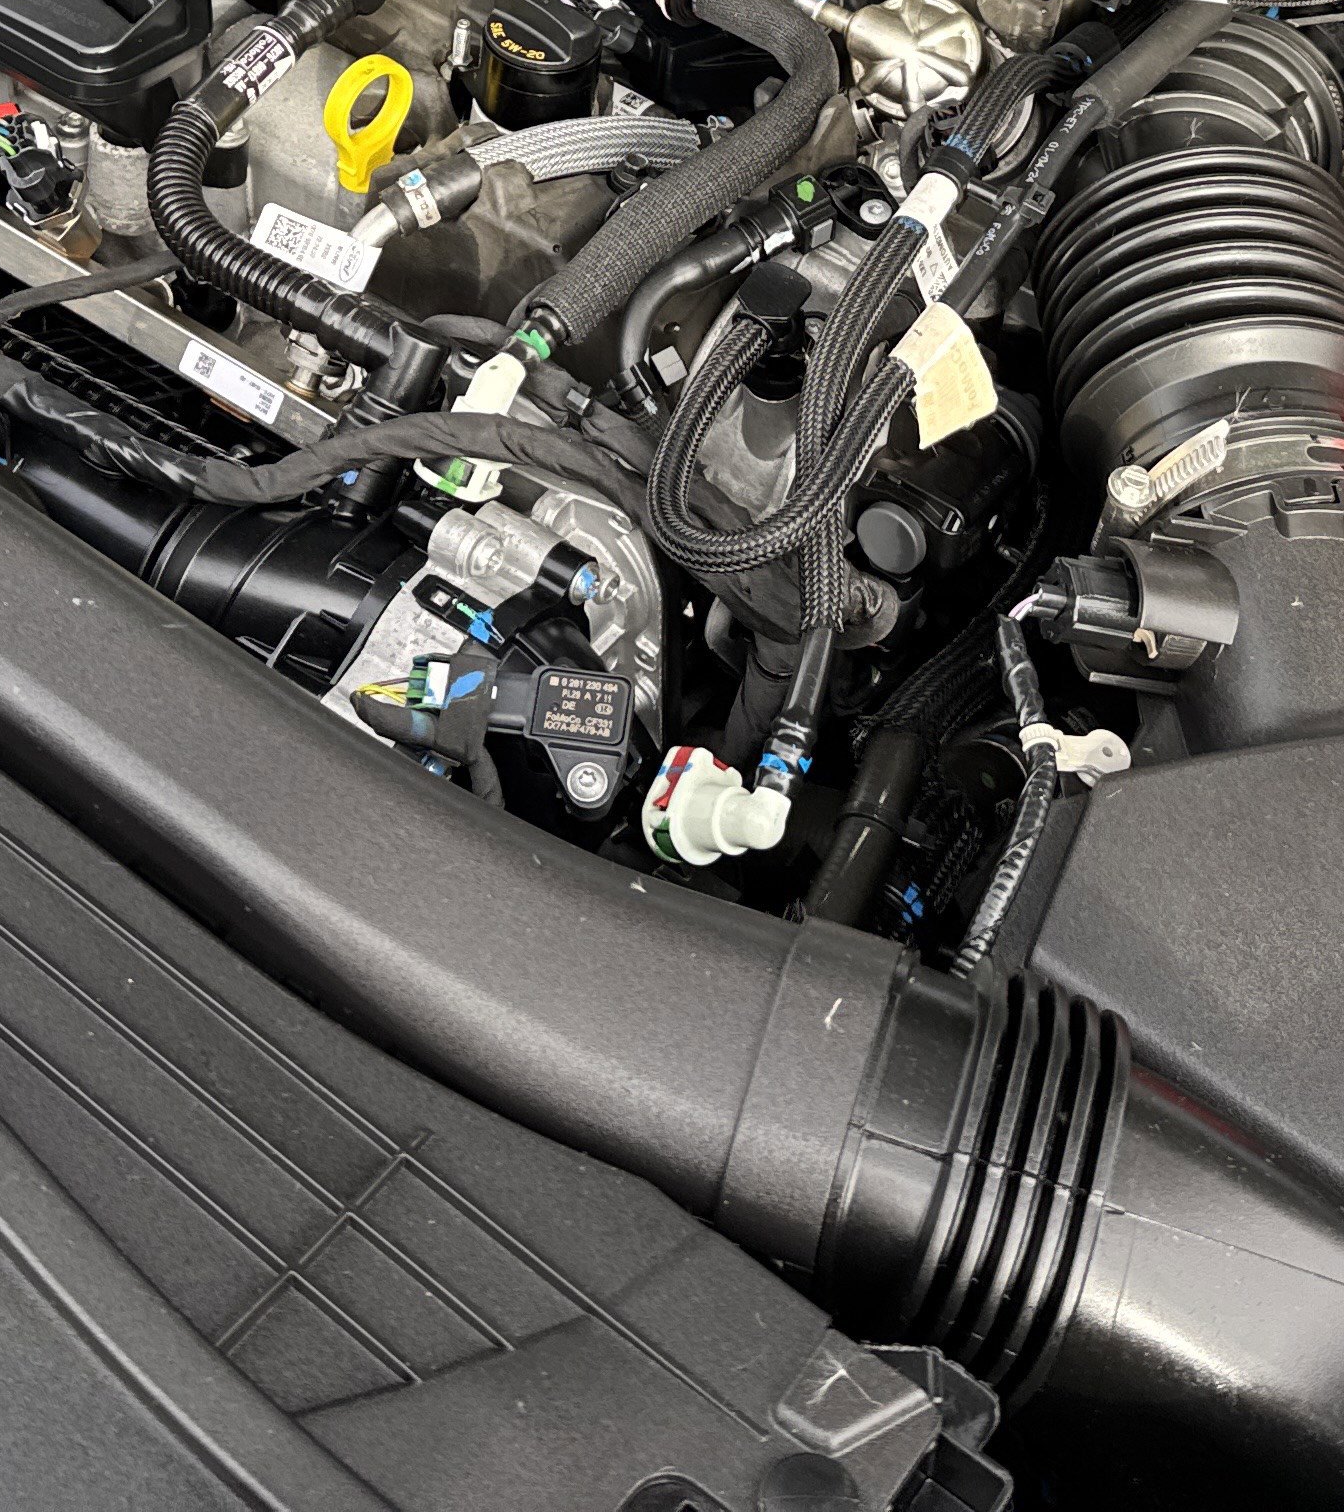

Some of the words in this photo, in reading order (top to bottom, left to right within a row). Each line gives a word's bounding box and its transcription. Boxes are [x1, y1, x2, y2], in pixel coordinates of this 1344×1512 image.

[490, 22, 507, 39] SAE
[501, 39, 546, 60] 5W-20
[243, 34, 269, 63] FoMoCo
[583, 691, 591, 700] A
[595, 693, 601, 702] 7
[561, 700, 576, 710] DE
[545, 711, 581, 724] FoMoCo
